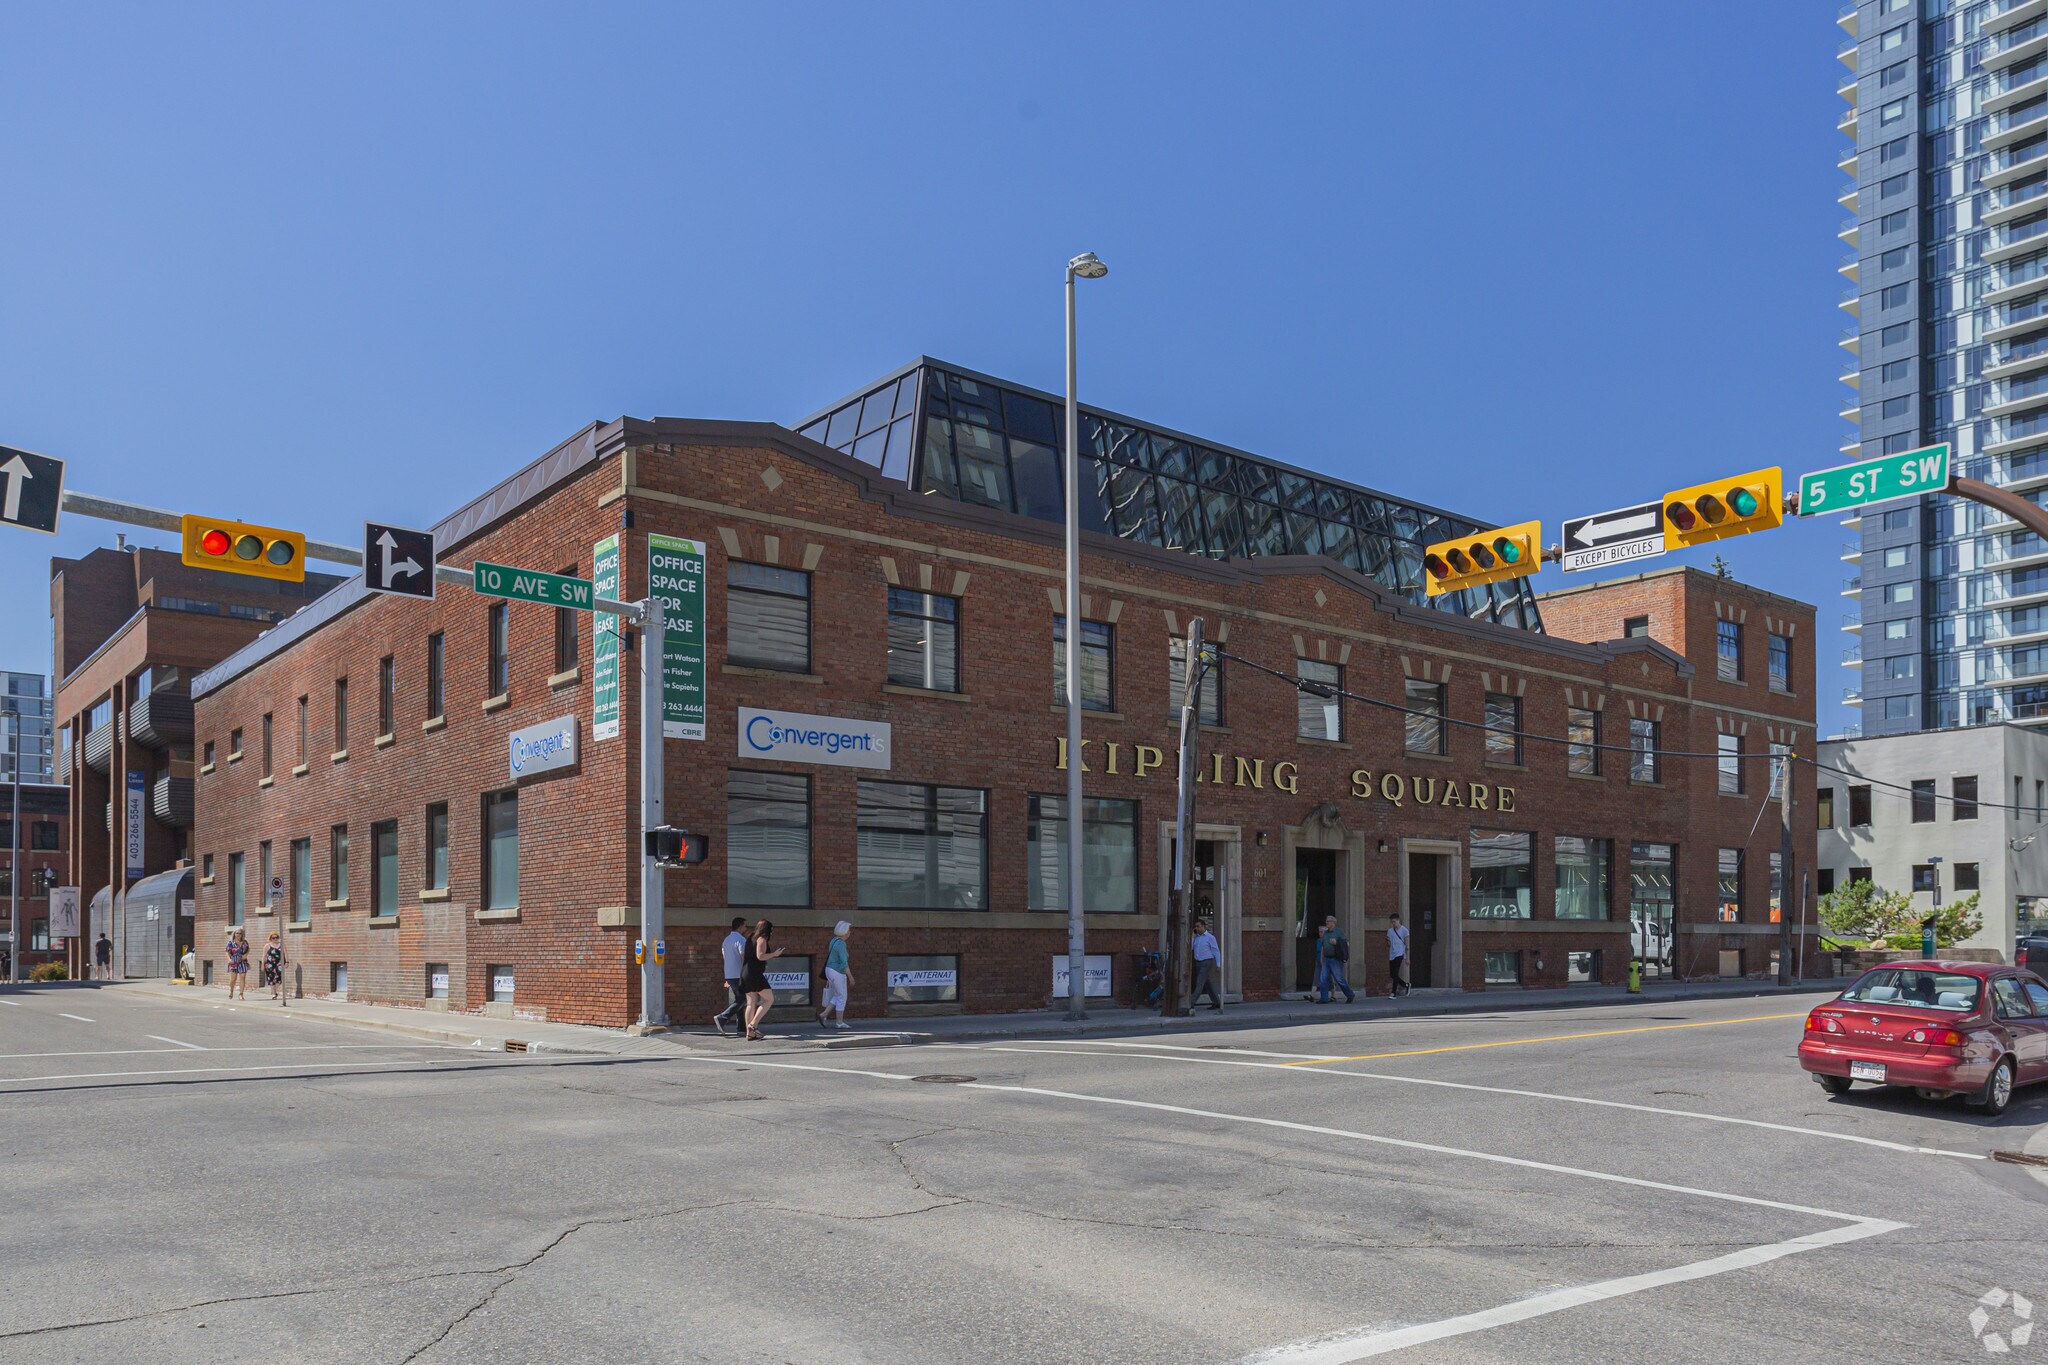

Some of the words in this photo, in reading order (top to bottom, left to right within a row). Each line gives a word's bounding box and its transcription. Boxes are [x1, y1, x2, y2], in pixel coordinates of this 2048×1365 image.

[1810, 480, 1826, 507] 5
[1848, 468, 1882, 498] ST
[1899, 454, 1942, 486] SW
[651, 538, 670, 547] OFFICE
[672, 542, 689, 550] SPACE
[1576, 550, 1606, 566] EXCEPT
[1611, 541, 1653, 559] BICYCLES
[595, 554, 618, 575] OFFICE
[652, 554, 702, 574] OFFICE
[480, 569, 501, 590] 10
[512, 576, 550, 598] AVE
[561, 583, 588, 604] SW
[594, 576, 615, 595] SPACE
[652, 574, 696, 593] SPACE
[596, 616, 614, 634] LEASE
[674, 654, 700, 663] Watson
[671, 668, 692, 676] Fisher
[672, 682, 699, 692] Sapieha
[668, 702, 682, 711] 263
[684, 704, 703, 713] 4444
[682, 728, 702, 736] CBRE
[1056, 736, 1299, 795] KIPING
[1352, 769, 1516, 813] SQUARE
[129, 798, 139, 860] 403-266-5544
[764, 973, 806, 981] NTERNAT
